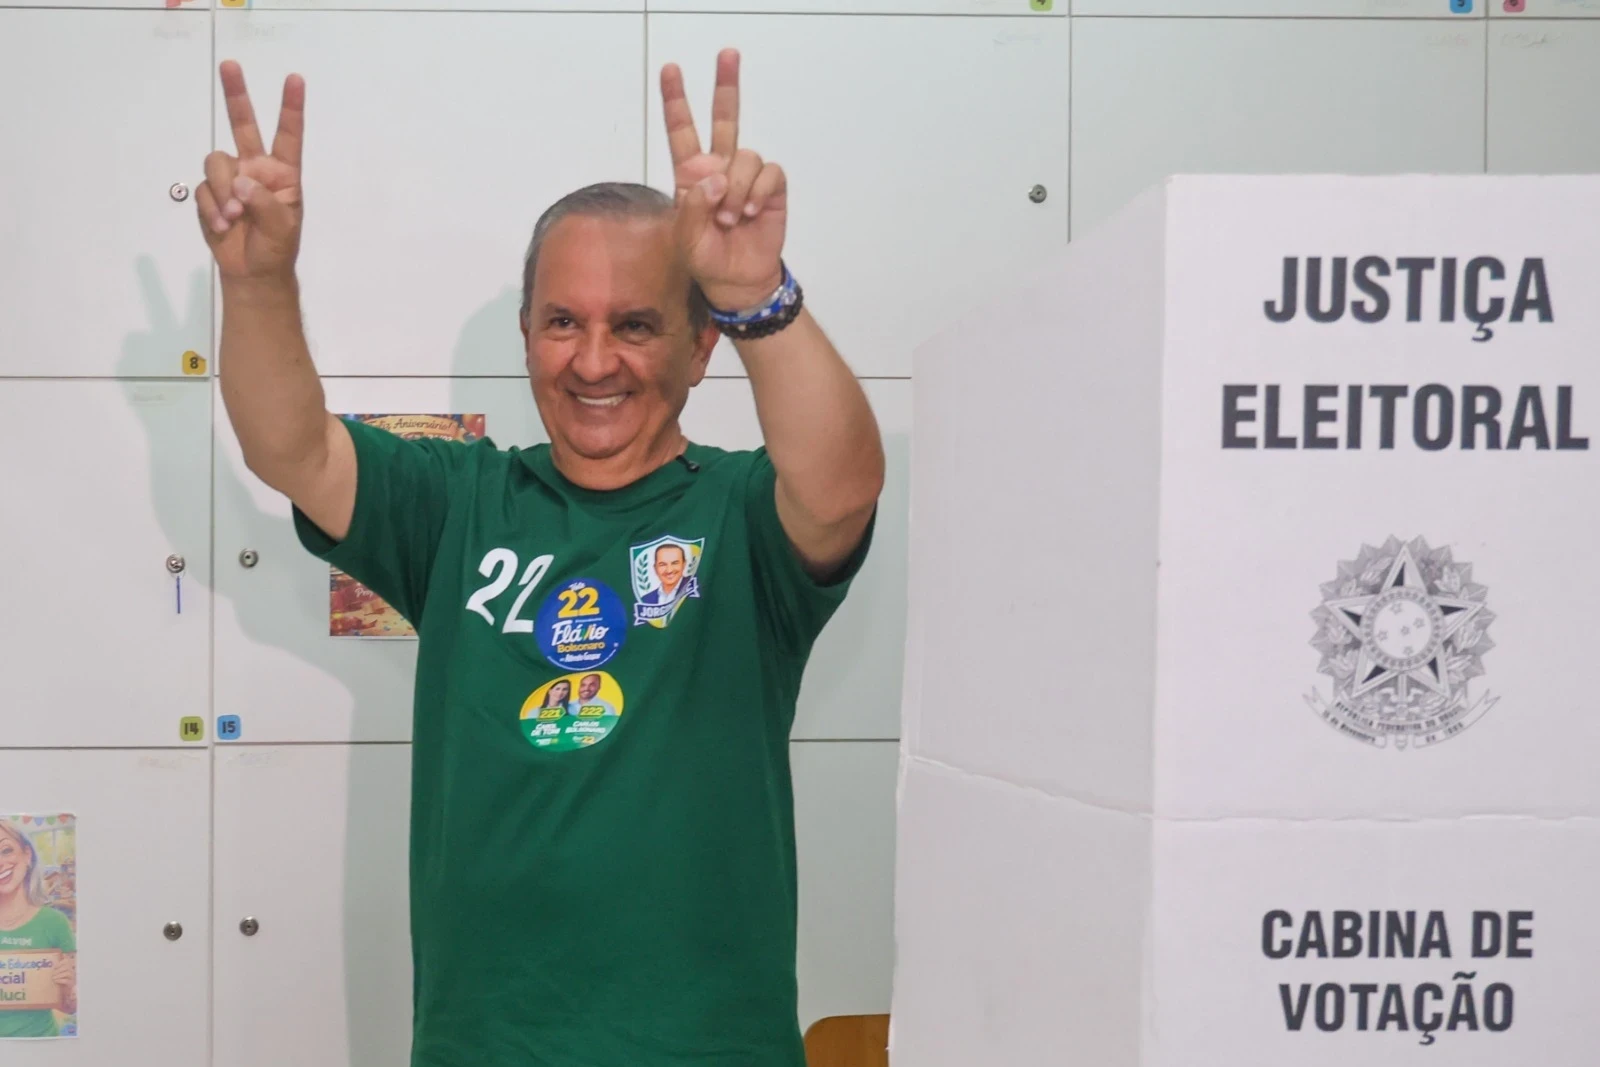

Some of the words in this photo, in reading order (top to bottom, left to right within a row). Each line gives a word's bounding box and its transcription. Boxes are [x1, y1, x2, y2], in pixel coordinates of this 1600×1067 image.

[1265, 255, 1554, 342] JUSTIÇA
[190, 356, 198, 369] 8
[1222, 383, 1589, 451] ELEITORAL
[466, 547, 554, 634] 22
[558, 587, 600, 618] 22
[551, 619, 609, 647] Flávio
[557, 641, 606, 653] Bolsonaro
[581, 706, 604, 716] 222
[184, 722, 200, 735] 14
[222, 721, 236, 734] 15
[1263, 909, 1452, 960] CABINA
[1471, 910, 1534, 959] DE
[8, 958, 53, 971] Educação
[1279, 971, 1514, 1046] VOTAÇÃO
